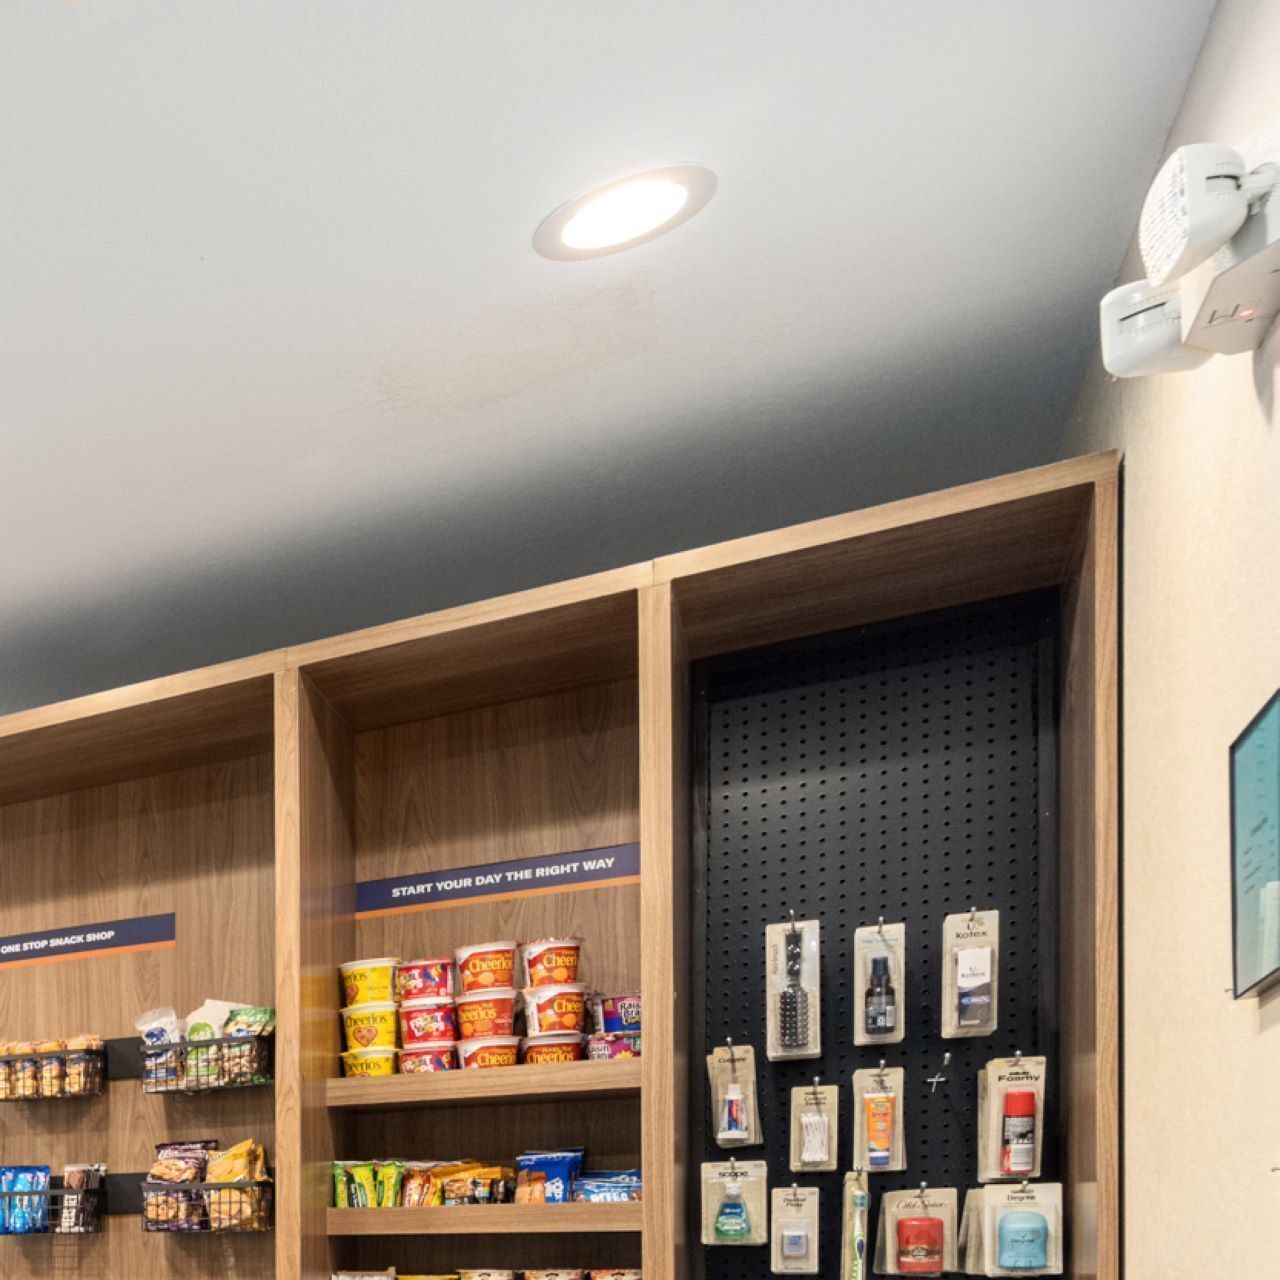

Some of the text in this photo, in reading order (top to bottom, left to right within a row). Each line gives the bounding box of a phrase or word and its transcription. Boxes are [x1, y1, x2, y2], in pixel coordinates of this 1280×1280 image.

[391, 857, 615, 898] START YOUR DAY THE RIGHT WAY
[0, 930, 115, 955] ONE STOP SNACK SHOP
